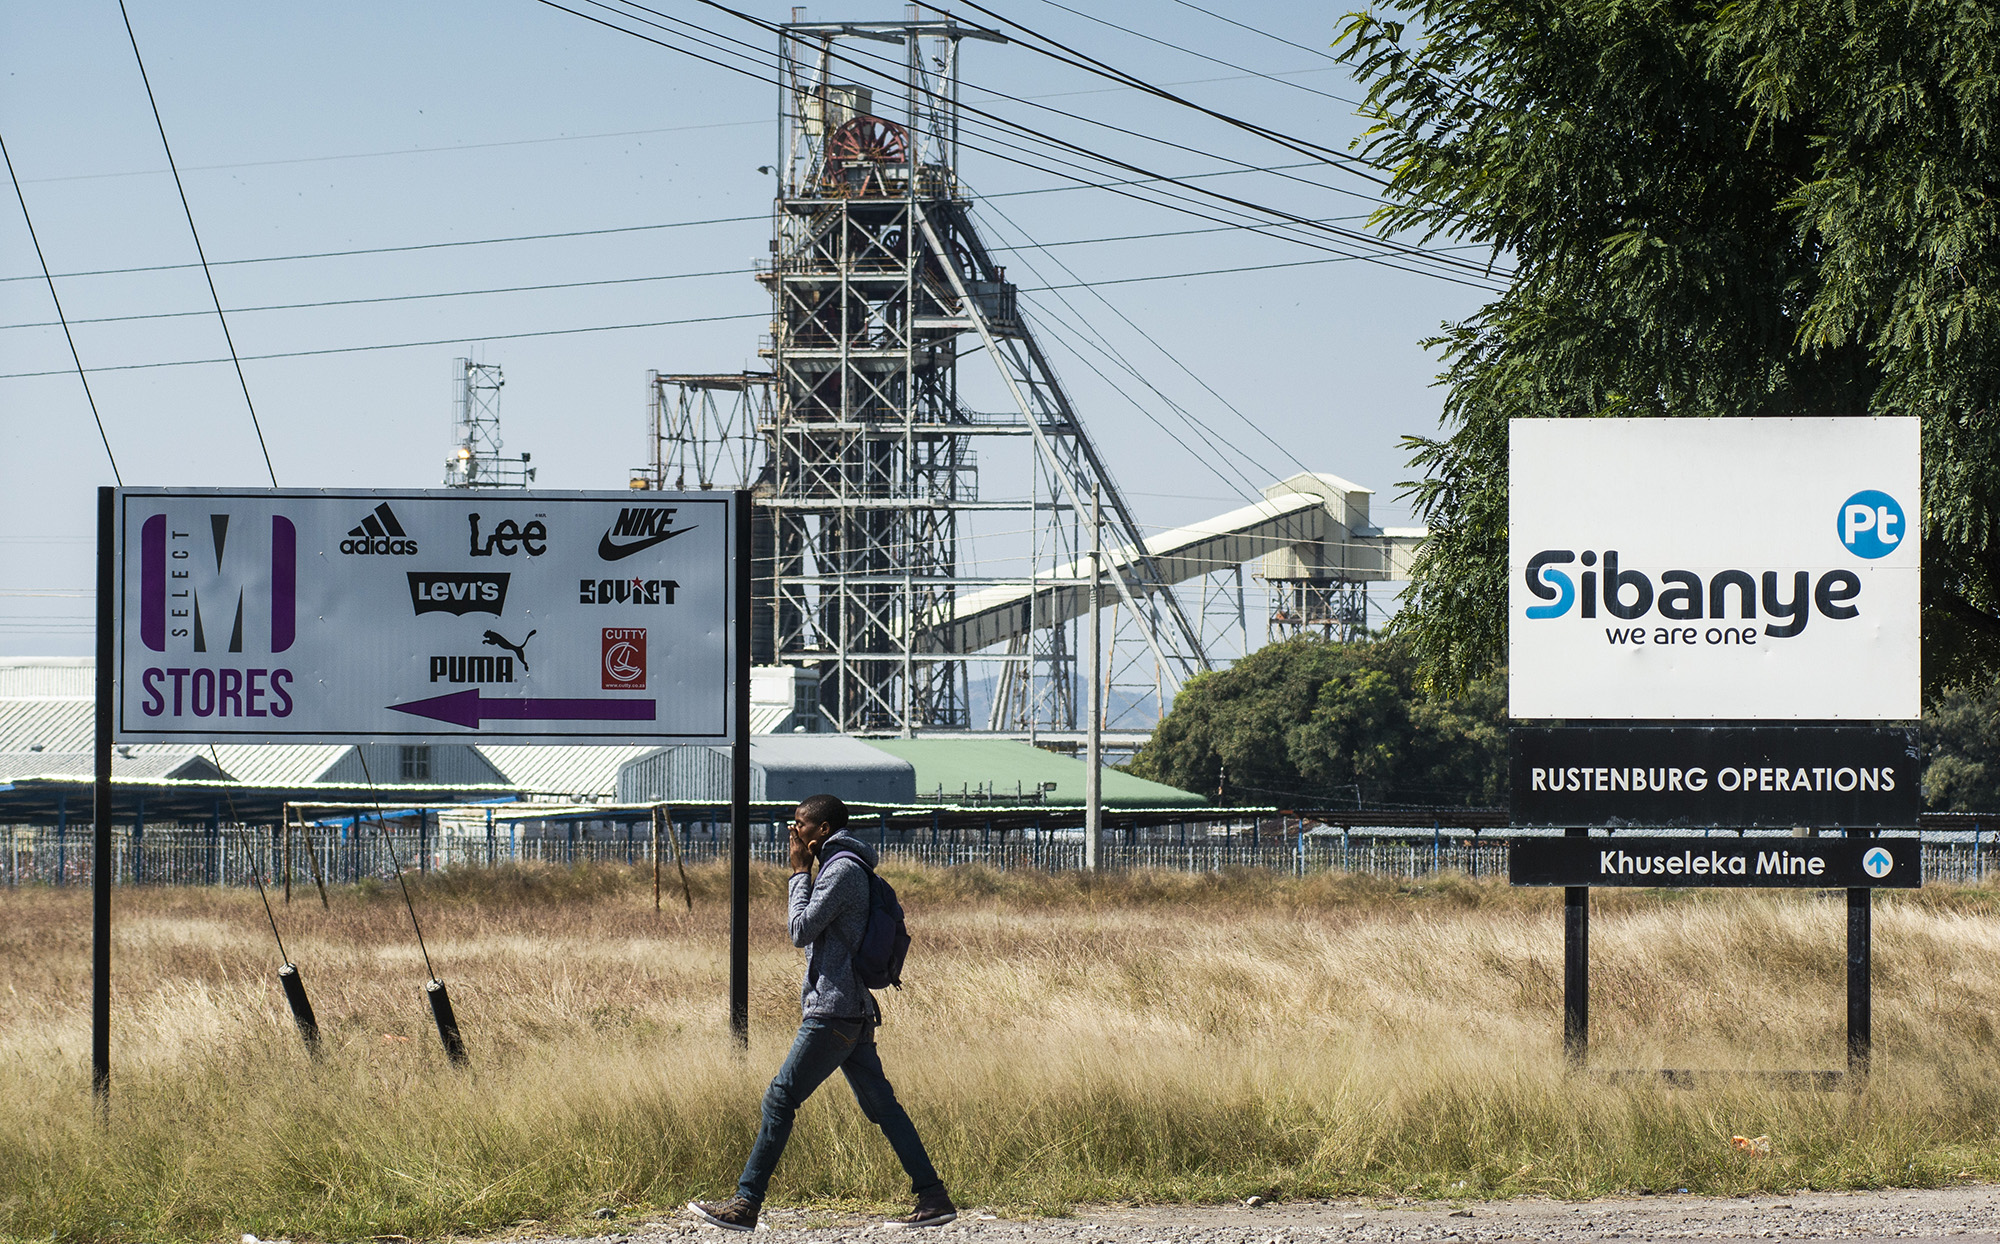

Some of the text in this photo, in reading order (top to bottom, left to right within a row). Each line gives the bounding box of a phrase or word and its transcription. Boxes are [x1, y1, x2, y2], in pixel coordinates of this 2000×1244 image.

[468, 512, 547, 557] Lee
[612, 508, 678, 536] NIKE
[1845, 504, 1899, 545] Pt
[339, 535, 418, 556] adidas
[172, 530, 189, 637] SELECT
[1525, 550, 1862, 638] Sibanye
[605, 629, 646, 640] CUTTY
[1605, 627, 1757, 646] we are one
[430, 656, 514, 683] PUMA
[142, 667, 293, 718] STORES
[1531, 767, 1896, 793] RUSTENBURG OPERATIONS
[1600, 850, 1826, 876] Khuseleka Mine
